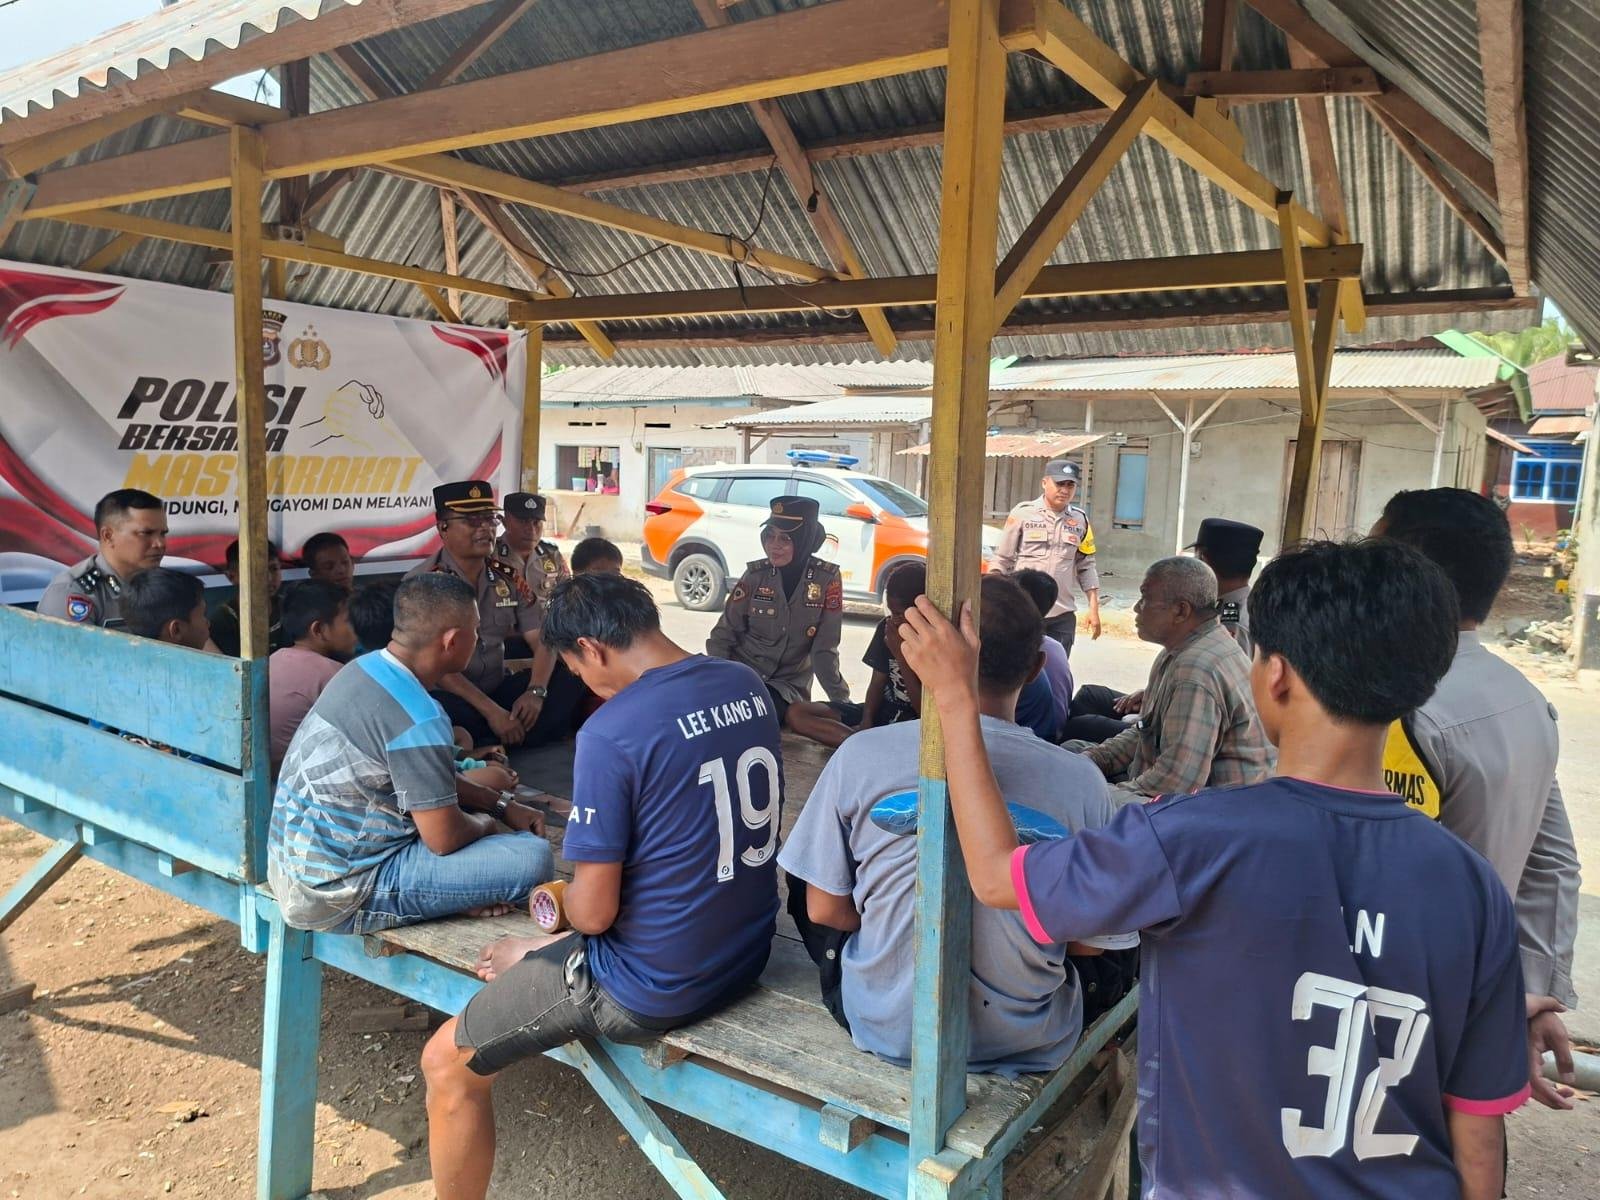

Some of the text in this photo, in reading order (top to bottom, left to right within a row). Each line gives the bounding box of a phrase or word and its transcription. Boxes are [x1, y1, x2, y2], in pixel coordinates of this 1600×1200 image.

[118, 423, 289, 452] BERSAA
[122, 452, 425, 497] MASARAKAT
[332, 497, 362, 510] DAN
[366, 496, 433, 509] MELAYANI
[677, 710, 711, 740] LEE
[710, 699, 752, 729] KANG
[698, 746, 780, 883] 19
[1281, 971, 1430, 1161] 32
